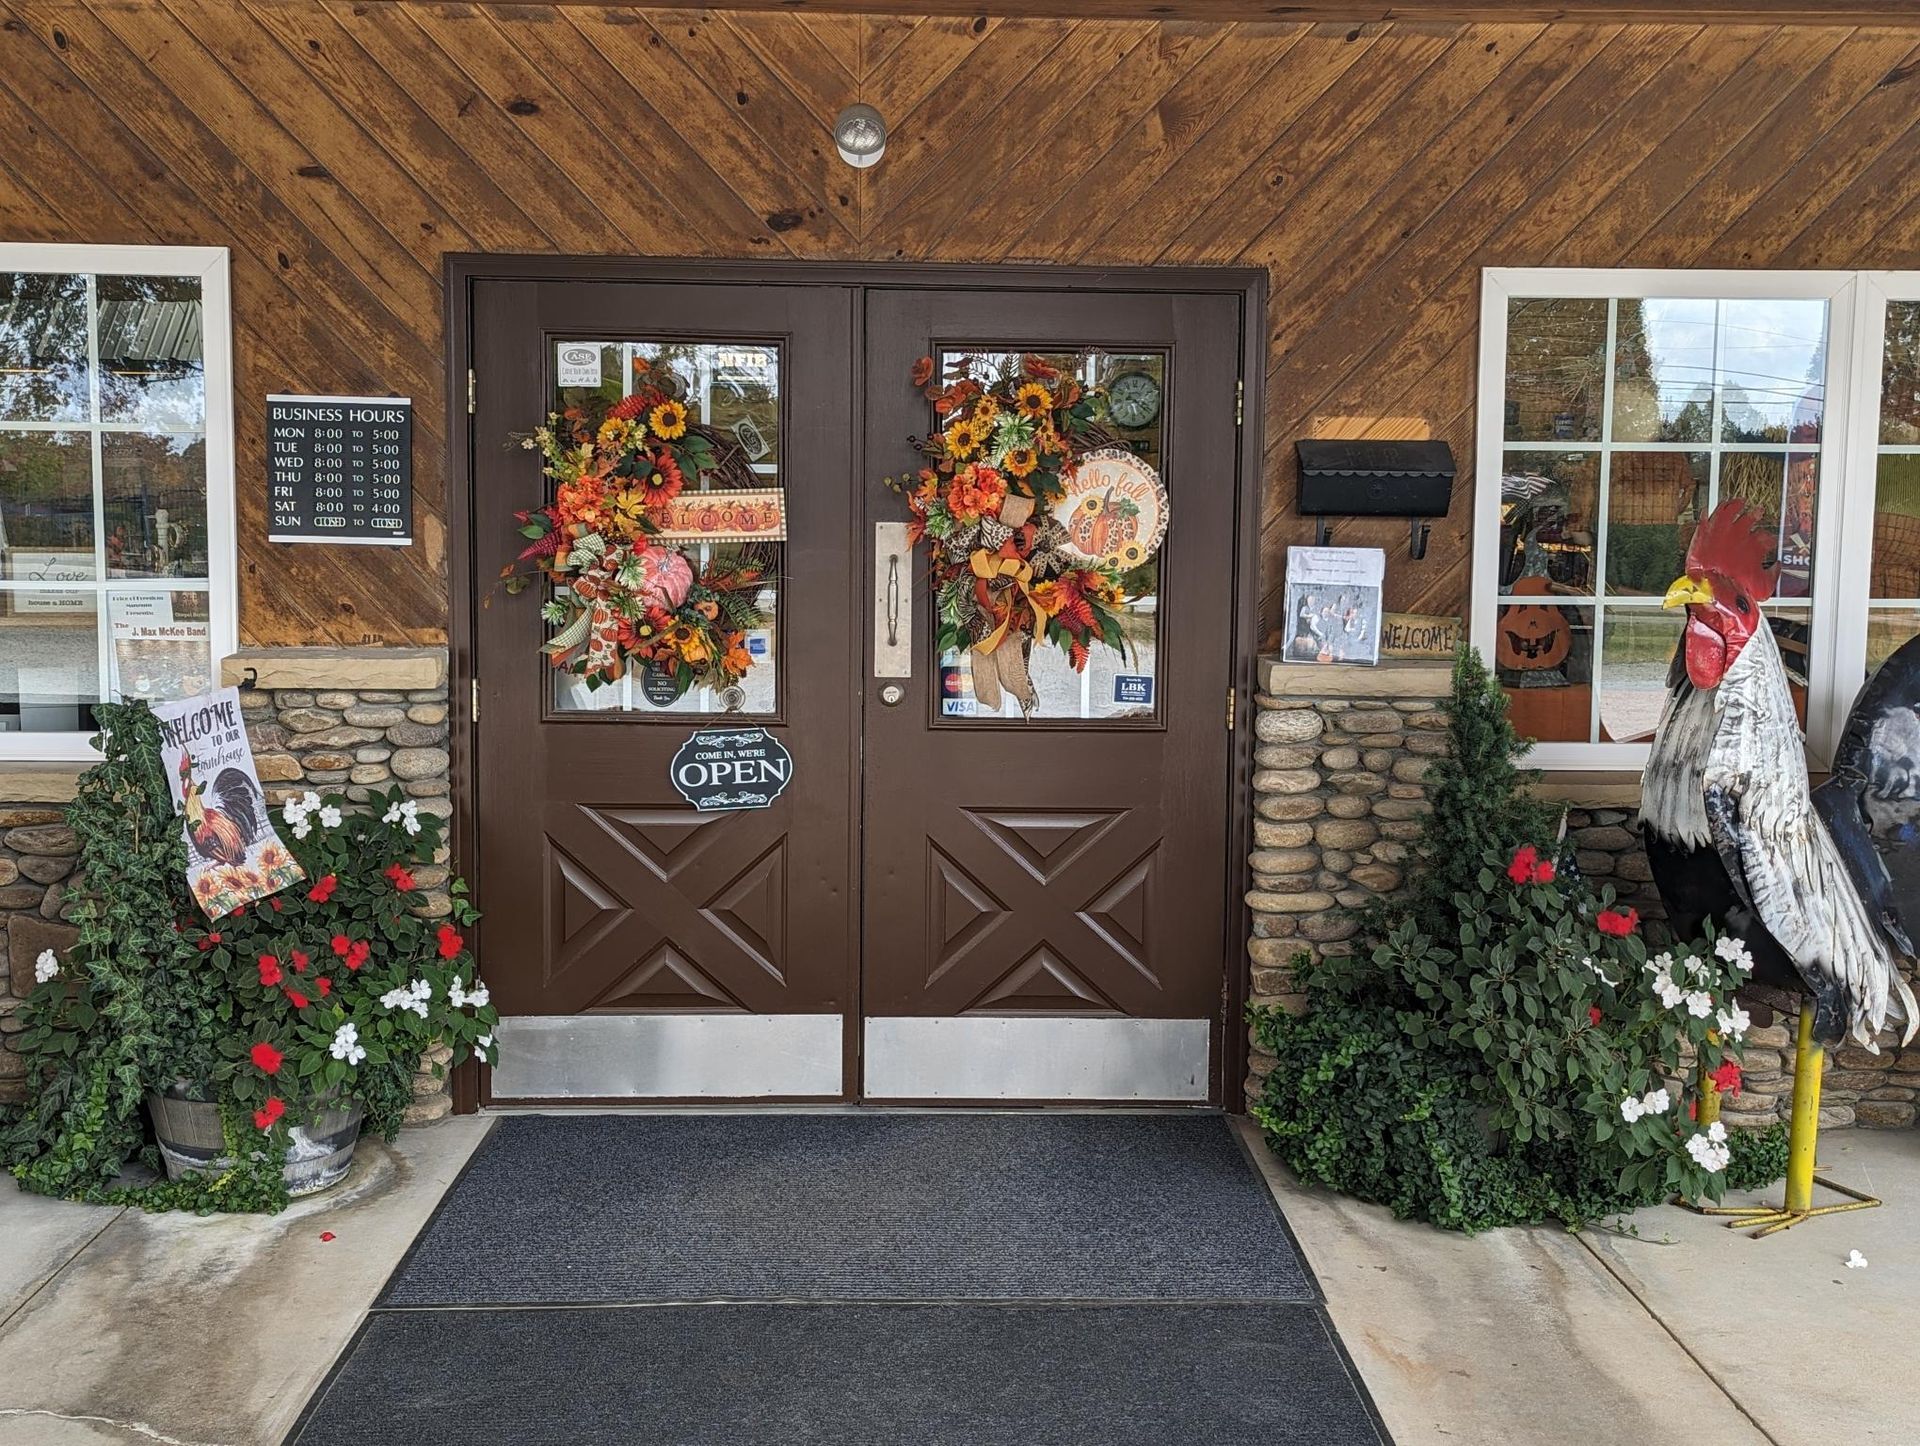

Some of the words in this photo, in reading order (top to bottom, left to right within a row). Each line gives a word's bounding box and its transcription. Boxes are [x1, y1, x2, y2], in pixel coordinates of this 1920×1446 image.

[273, 407, 343, 421] BUSINESS
[349, 409, 405, 423] HOURS
[274, 427, 305, 438] MON
[314, 428, 343, 440] 8:00
[352, 430, 364, 438] TO
[372, 429, 399, 441] 5:00
[274, 441, 298, 453] TUE
[314, 443, 343, 454] 8:00
[352, 445, 364, 453] TO
[371, 444, 399, 455] 5:00
[274, 457, 304, 468] WED
[314, 458, 343, 469] 8:00
[352, 460, 364, 468] TO
[371, 459, 400, 470] 5:00
[274, 471, 301, 482] THU
[314, 473, 343, 483] 8:00
[352, 474, 364, 482] TO
[372, 474, 400, 485] 5:00
[1068, 468, 1111, 497] hello
[1115, 472, 1150, 501] fall
[274, 486, 293, 497] FRI
[315, 487, 343, 498] 8:00
[352, 489, 364, 497] TO
[372, 488, 400, 499] 5:00
[274, 501, 297, 512] SAT
[315, 502, 344, 513] 8:00
[352, 504, 364, 512] TO
[371, 503, 400, 514] 4:00
[275, 516, 301, 527] SUN
[314, 516, 346, 527] CLOSED
[353, 518, 364, 526] TO
[371, 518, 403, 529] CLOSED
[661, 510, 773, 526] ELCOME
[28, 557, 88, 581] Love
[131, 627, 140, 636] J.
[141, 627, 157, 636] Max
[158, 627, 185, 636] McKee
[186, 627, 206, 636] Band
[1381, 623, 1454, 652] WELCOME
[1121, 683, 1146, 692] LBK
[947, 702, 975, 712] VISA
[160, 701, 237, 749] WELCOME
[211, 735, 223, 747] TO
[225, 729, 241, 743] OUR
[695, 751, 723, 761] COME
[724, 751, 737, 760] IN,
[737, 749, 766, 758] WE'RE
[679, 758, 787, 787] OPEN
